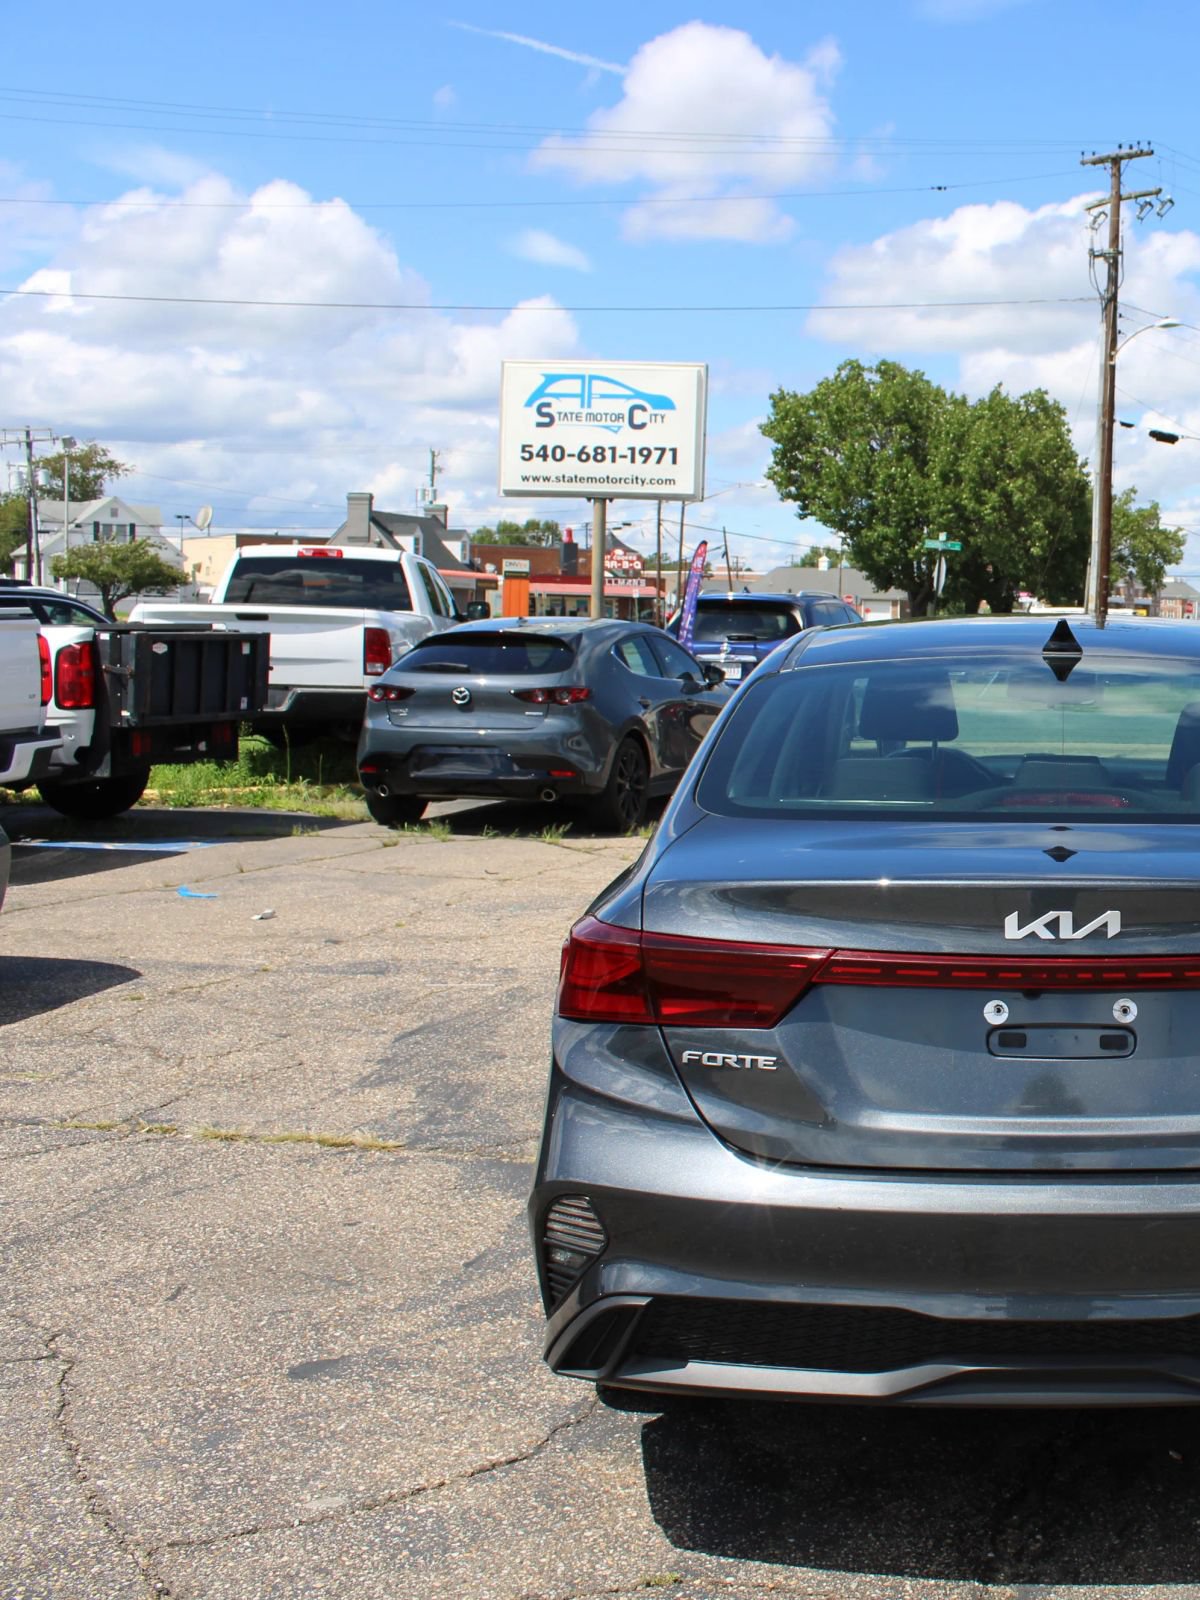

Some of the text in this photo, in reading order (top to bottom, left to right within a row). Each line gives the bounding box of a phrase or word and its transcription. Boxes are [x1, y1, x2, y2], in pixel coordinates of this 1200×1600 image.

[520, 444, 678, 465] 540-681-1971
[520, 473, 677, 487] www.statemotorcity.com
[604, 560, 641, 569] AR-B-Q
[605, 578, 646, 586] LLMAN'S
[1004, 910, 1121, 940] KIA
[681, 1049, 779, 1071] FORTE
